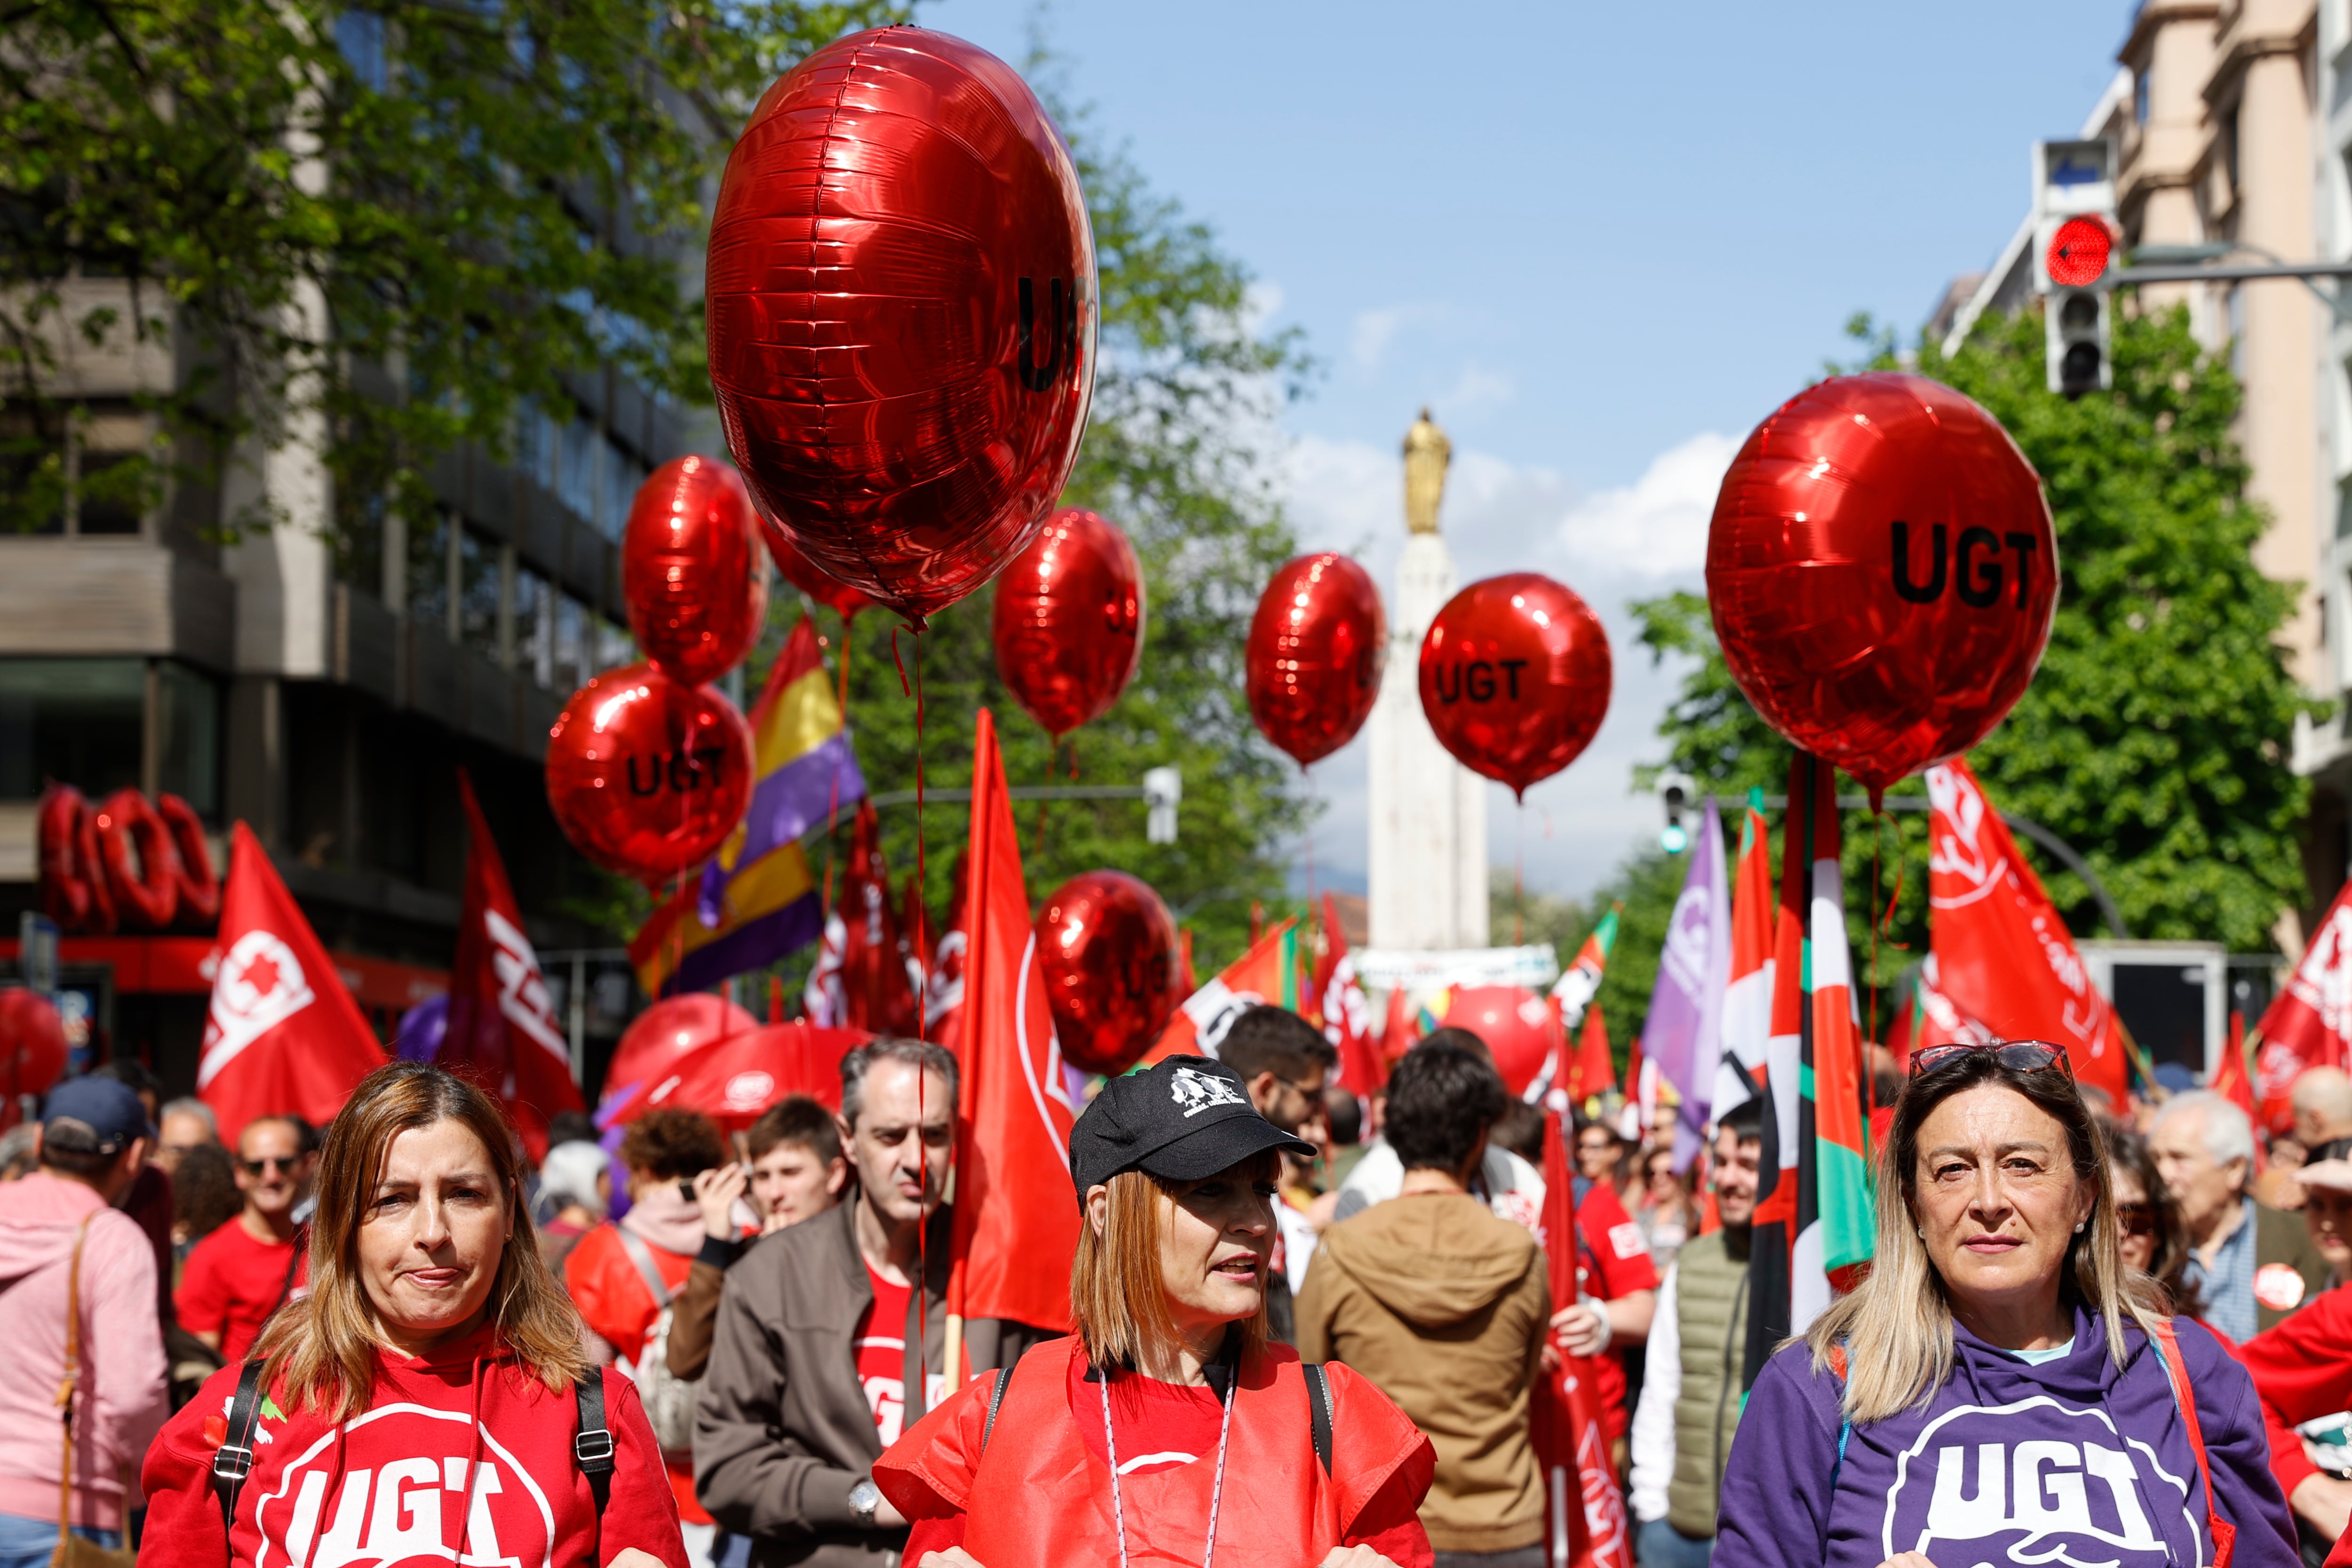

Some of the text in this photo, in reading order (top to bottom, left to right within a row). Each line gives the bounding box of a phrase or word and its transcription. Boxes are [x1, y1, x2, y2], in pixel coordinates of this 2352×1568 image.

[1891, 521, 2037, 610] UGT
[1437, 660, 1527, 703] UGT
[628, 748, 725, 796] UGT
[285, 1456, 522, 1566] UGT
[1927, 1440, 2165, 1549] UGT
